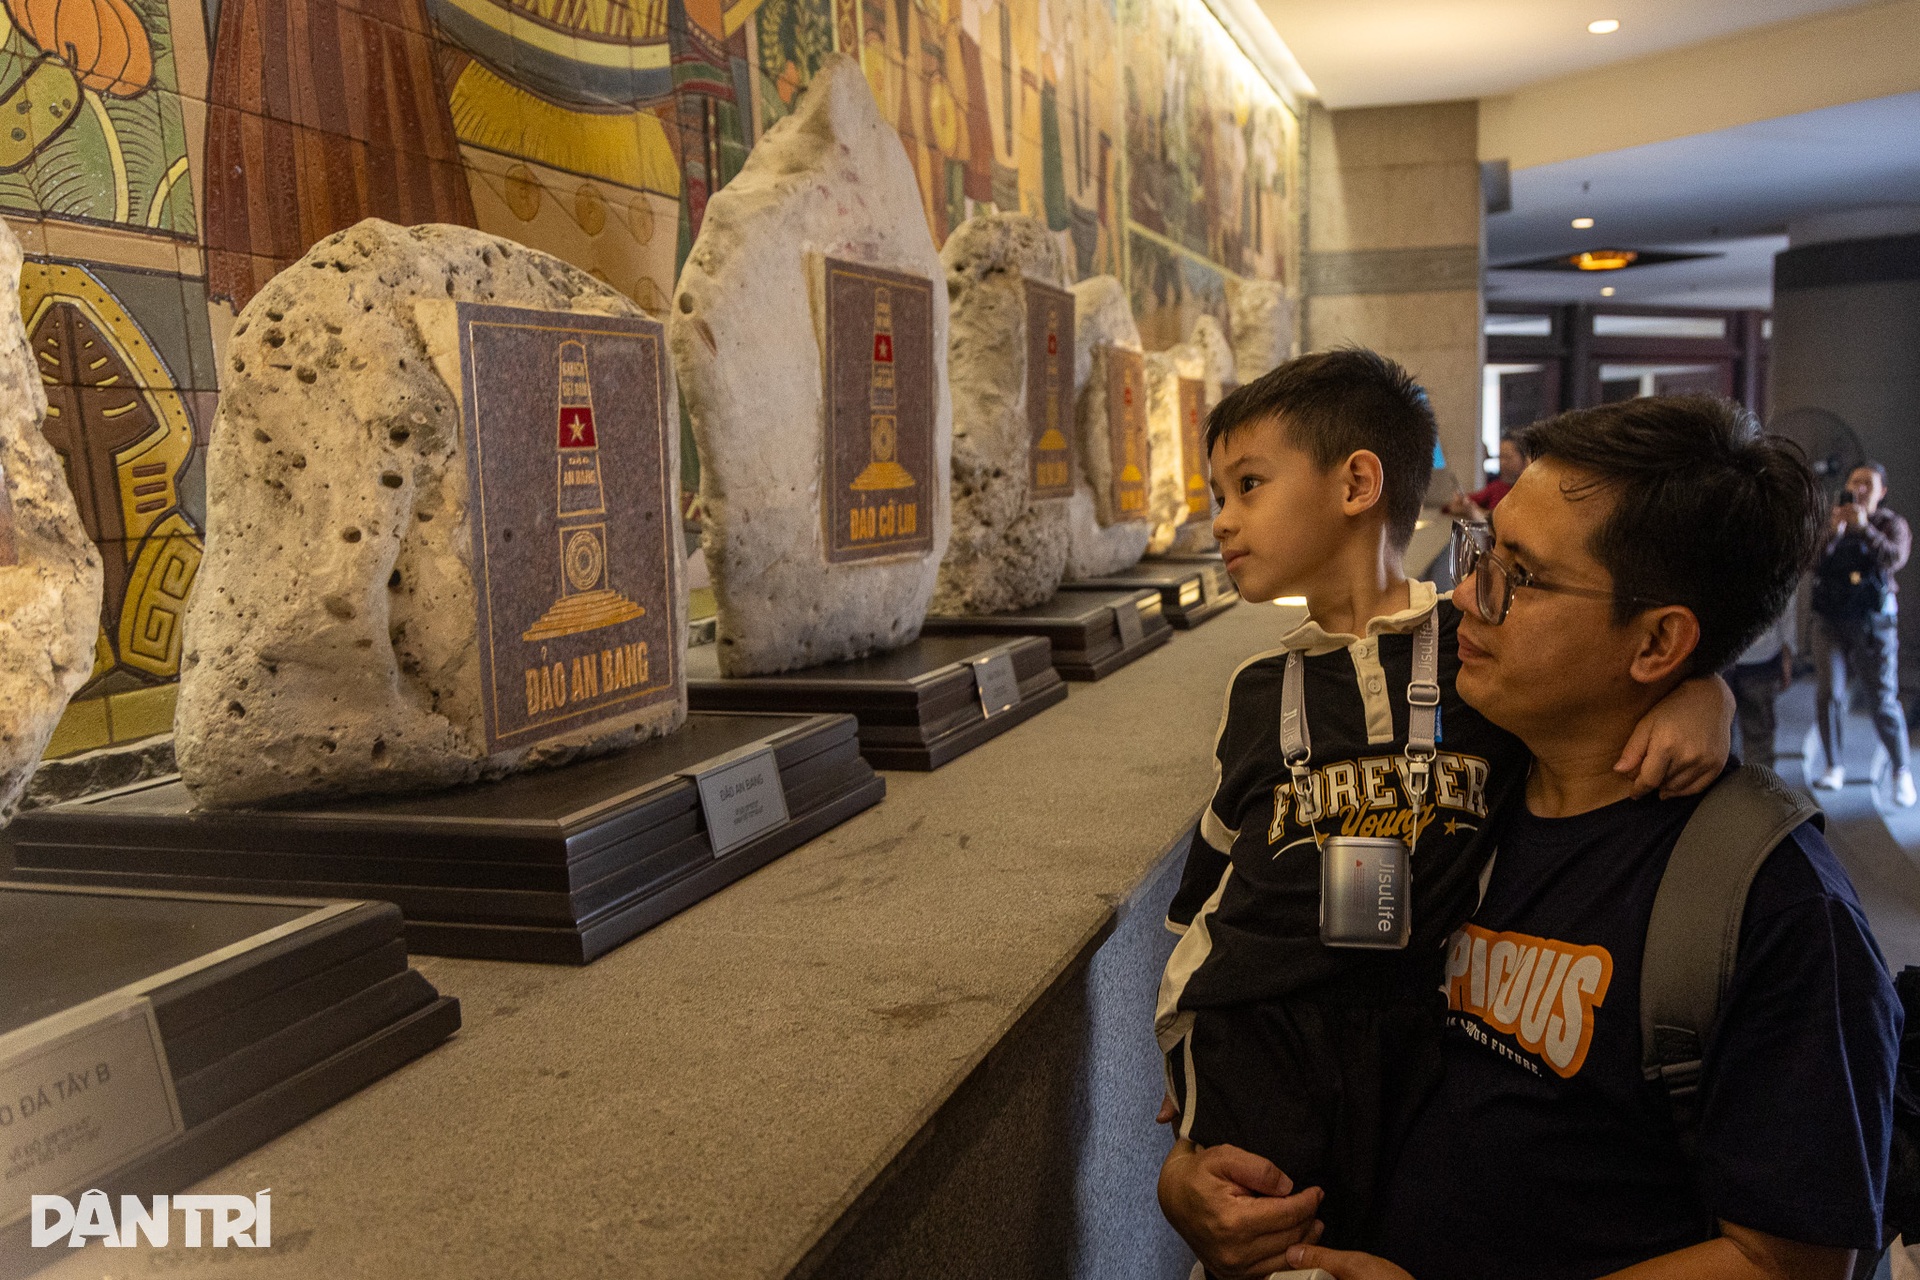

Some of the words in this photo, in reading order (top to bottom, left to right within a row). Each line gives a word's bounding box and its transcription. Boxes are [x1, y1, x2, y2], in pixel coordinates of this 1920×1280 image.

[571, 653, 599, 702] AN
[601, 641, 649, 694] BANG
[1418, 622, 1434, 671] JisuLife
[1268, 751, 1490, 845] FOREVER
[1338, 800, 1436, 847] Young
[1377, 860, 1395, 932] JisuLife
[96, 1061, 111, 1085] B
